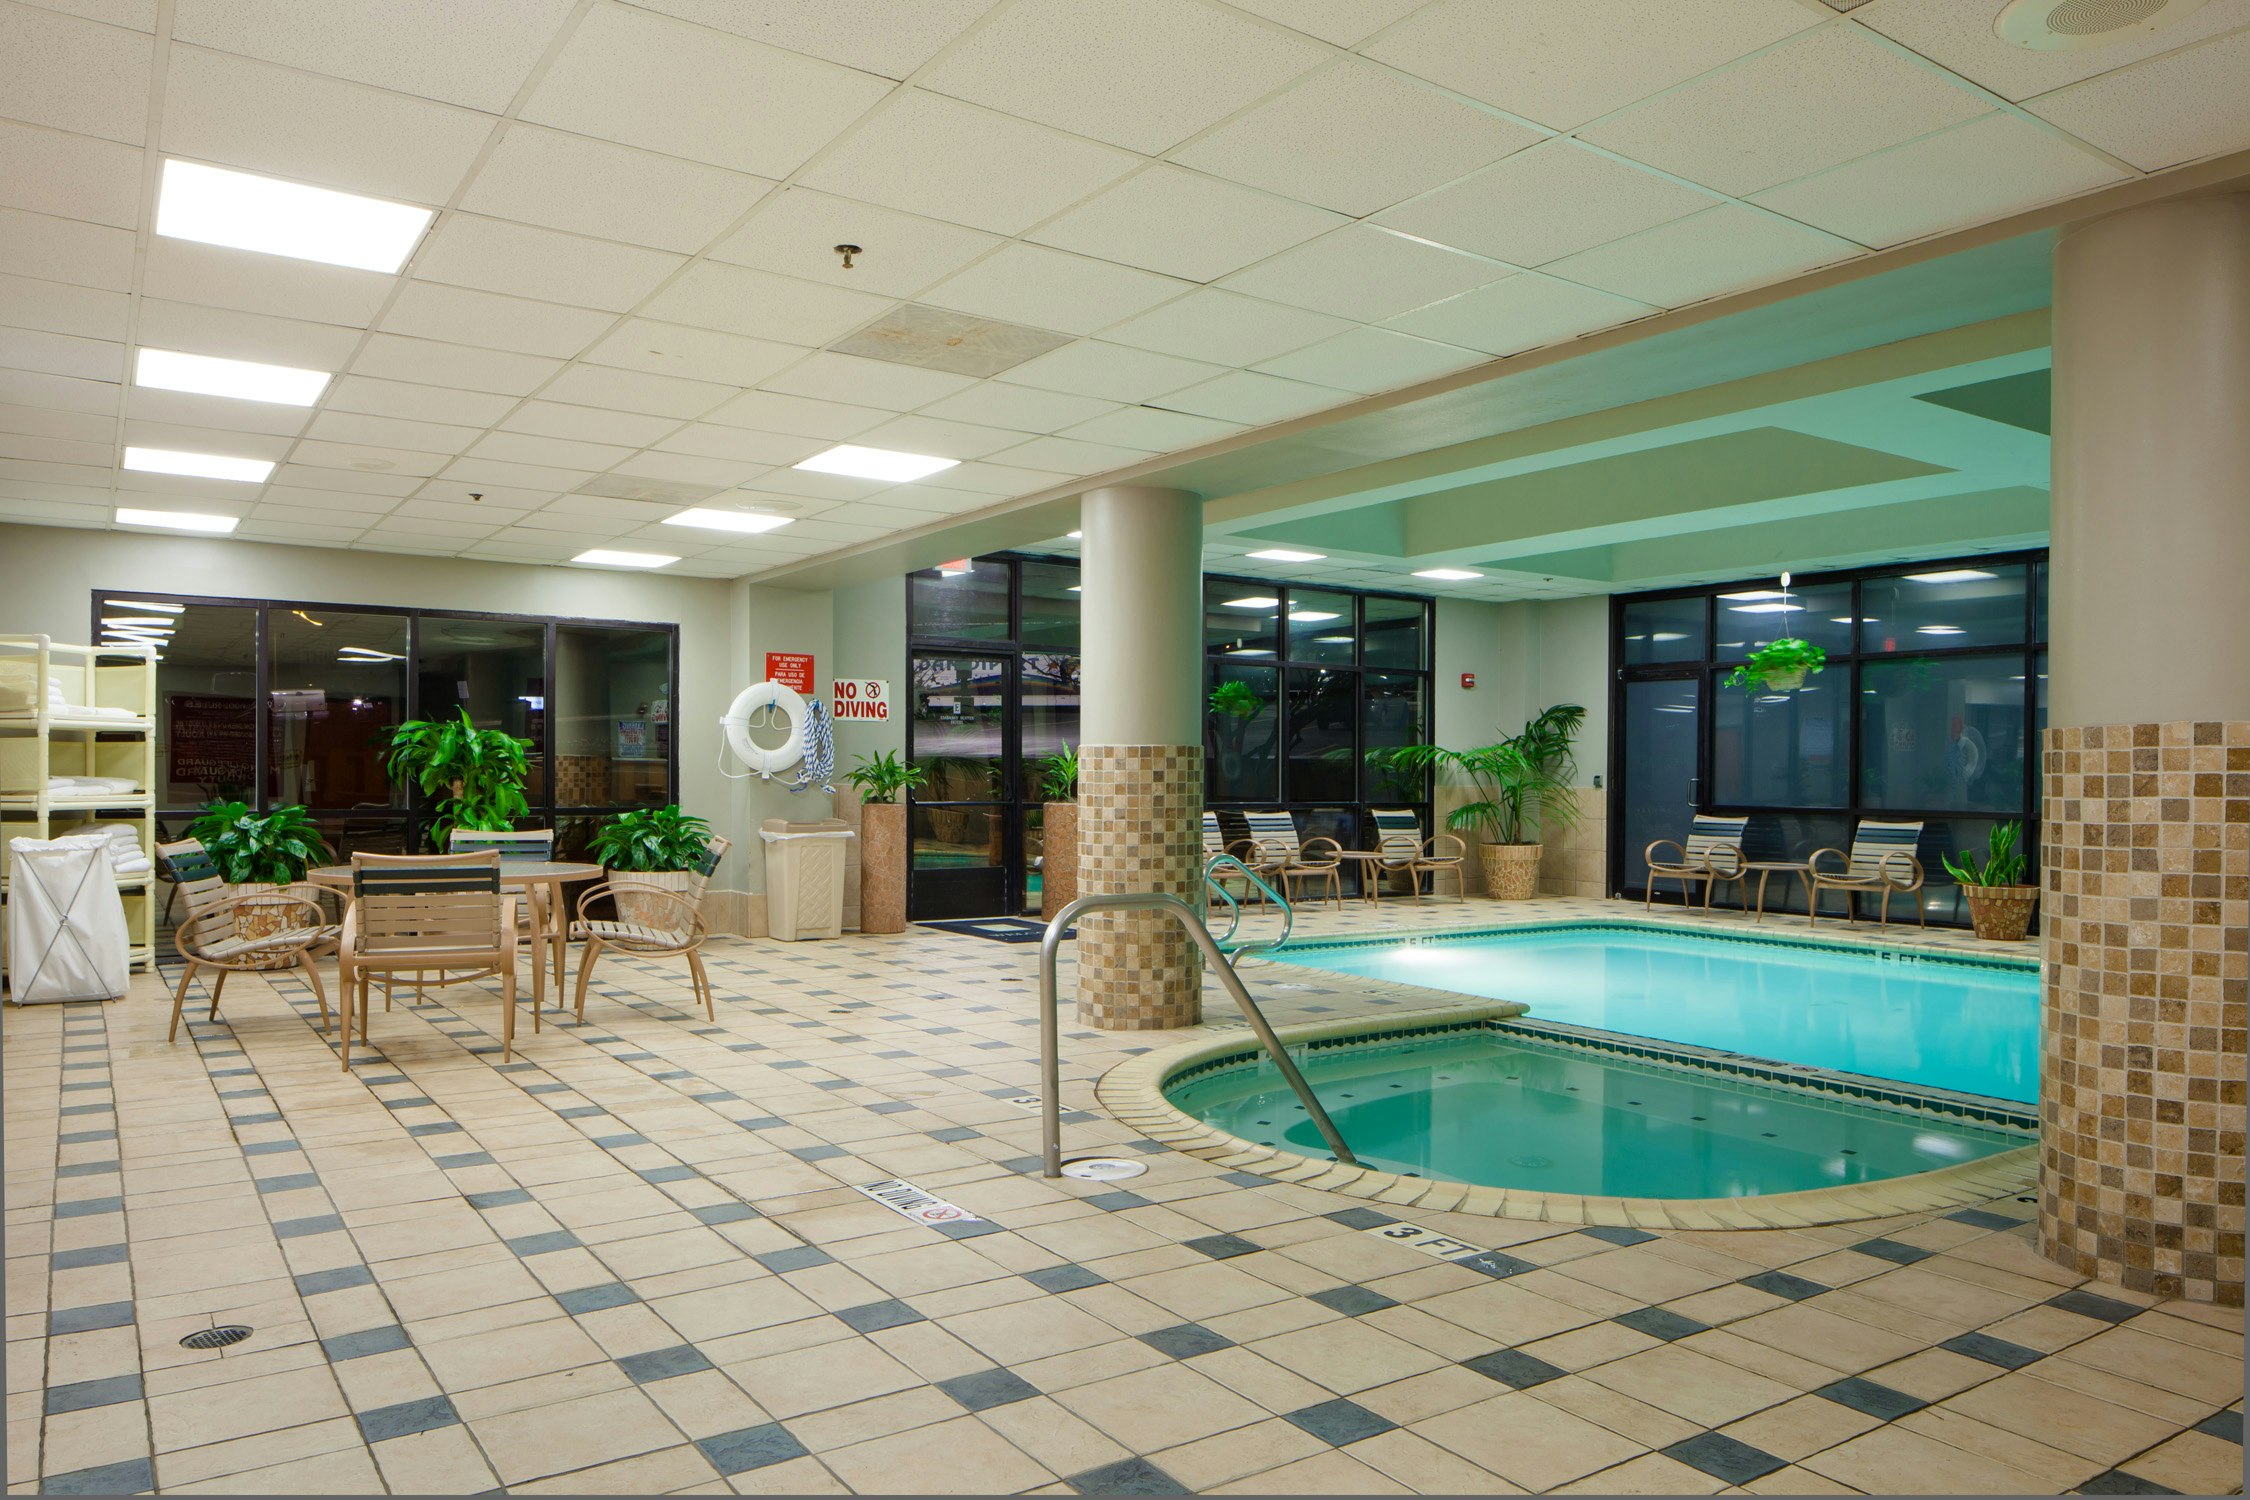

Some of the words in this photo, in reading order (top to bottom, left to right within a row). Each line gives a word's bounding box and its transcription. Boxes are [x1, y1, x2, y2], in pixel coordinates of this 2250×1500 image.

[834, 682, 857, 699] NO
[834, 701, 887, 718] DIVING
[863, 1180, 903, 1191] NO
[876, 1188, 938, 1210] DIVING
[1383, 1227, 1423, 1238] 3
[1414, 1238, 1480, 1255] FT
